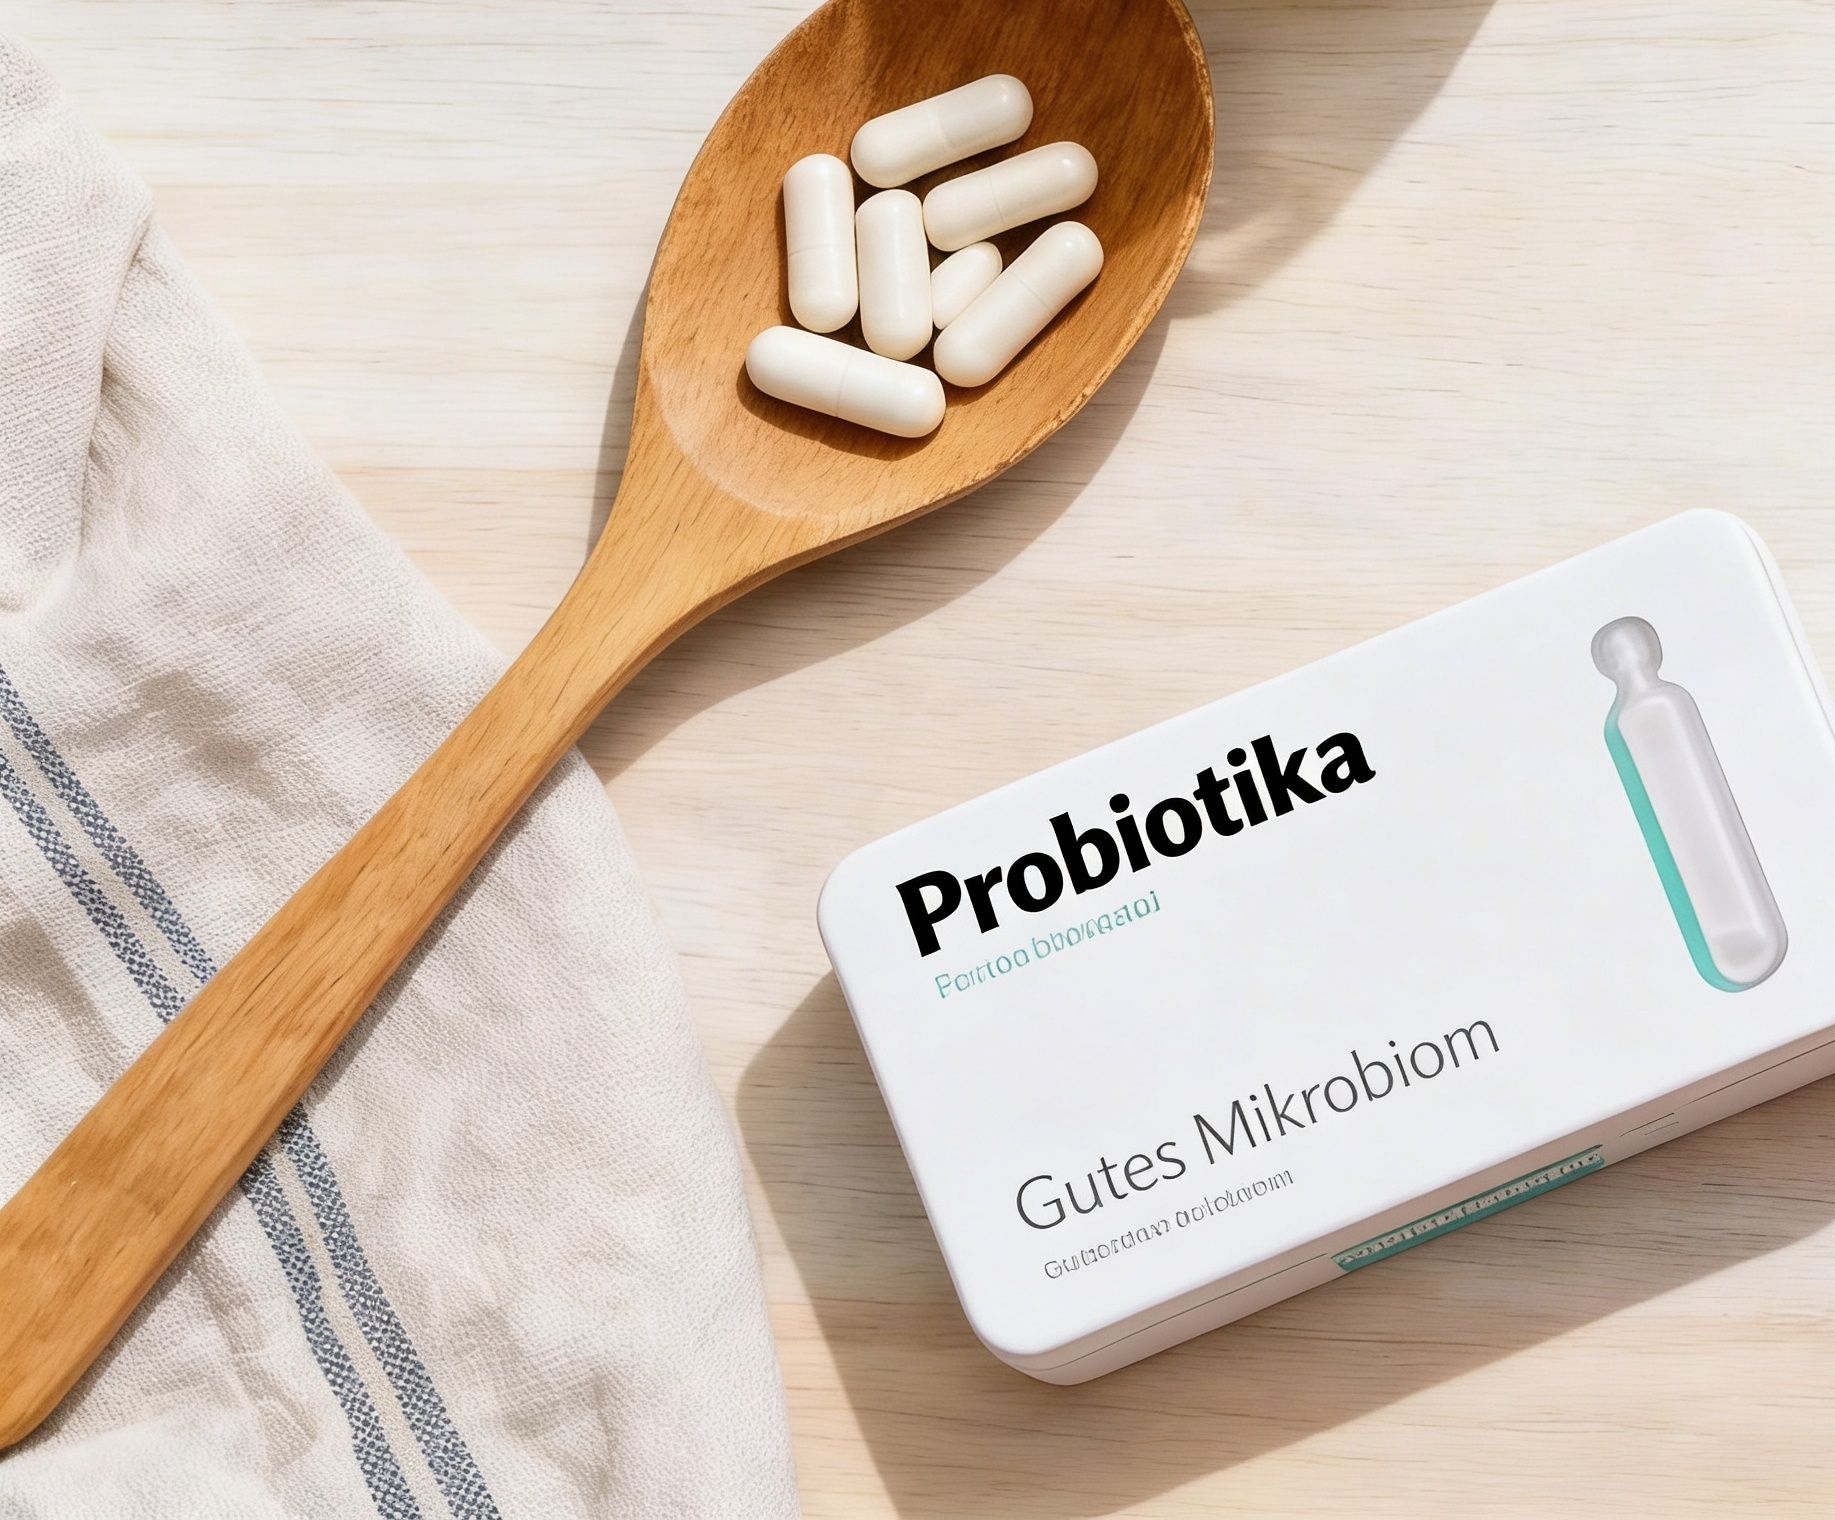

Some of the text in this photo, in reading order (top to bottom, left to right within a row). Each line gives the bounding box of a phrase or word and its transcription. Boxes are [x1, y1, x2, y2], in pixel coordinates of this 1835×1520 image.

[895, 731, 1376, 957] Probiotika
[1016, 1141, 1187, 1230] Gutes
[1193, 1019, 1500, 1165] Mikrobiom
